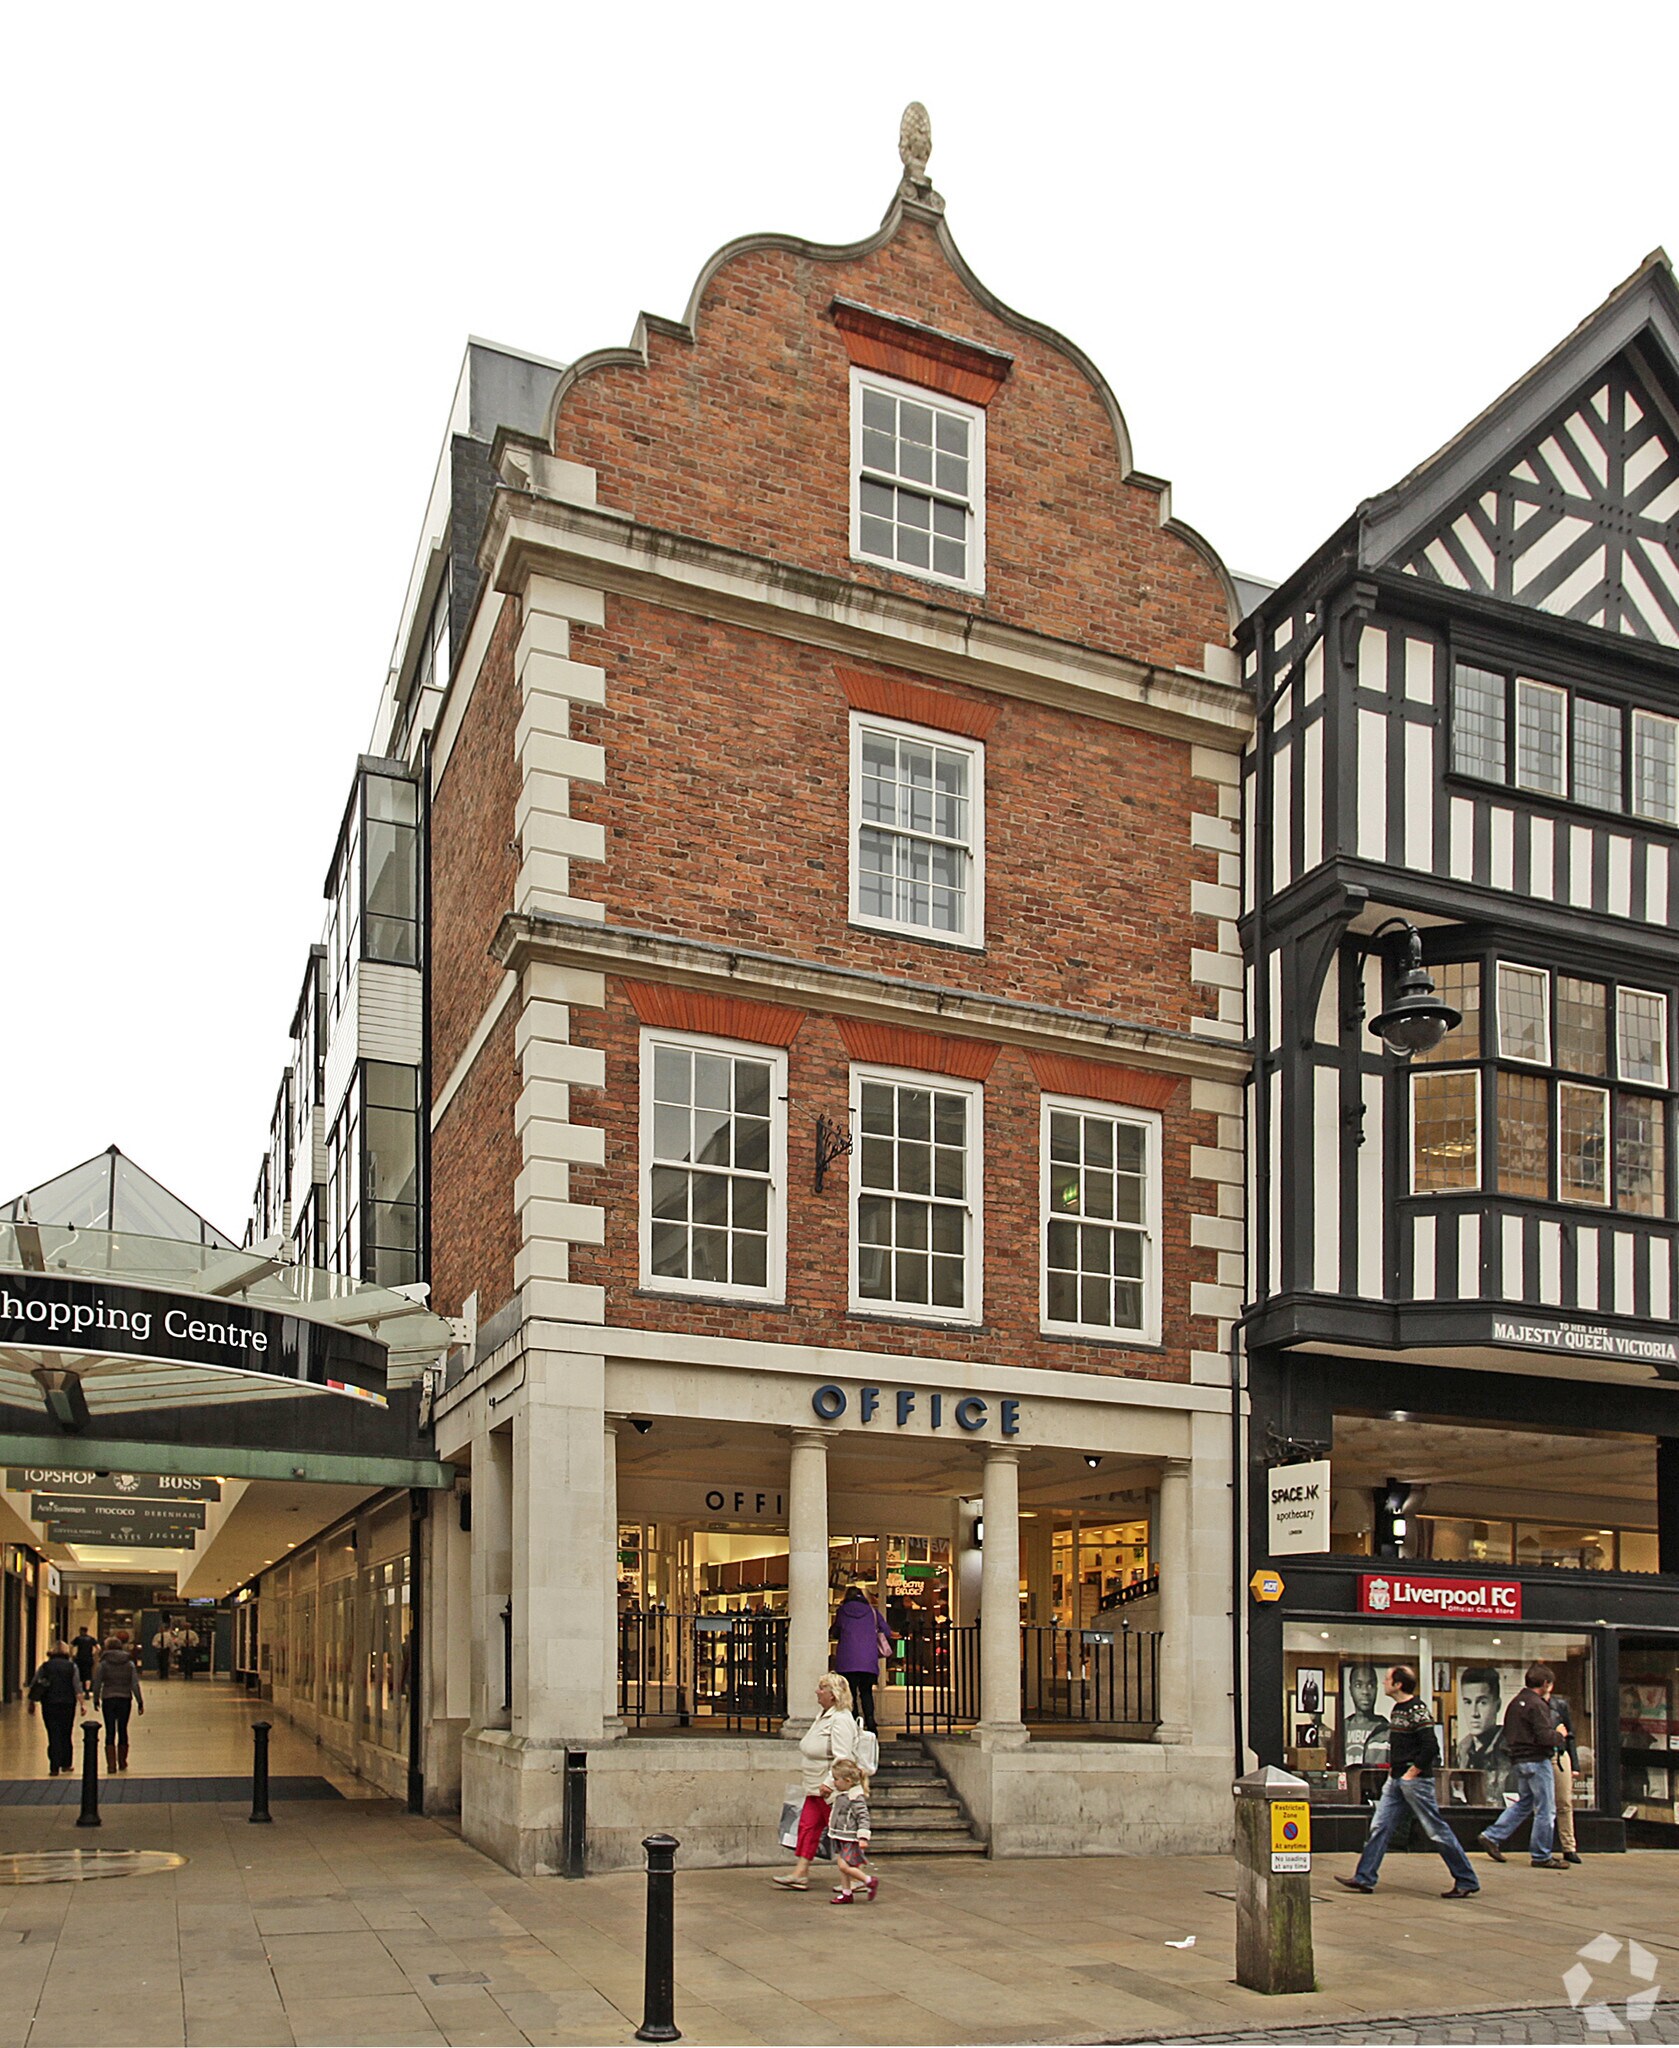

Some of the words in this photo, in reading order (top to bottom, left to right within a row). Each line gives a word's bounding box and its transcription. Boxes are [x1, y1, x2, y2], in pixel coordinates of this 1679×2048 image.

[0, 1290, 152, 1340] hopping
[164, 1309, 268, 1352] Centre
[1559, 1322, 1569, 1331] TO
[1571, 1324, 1586, 1333] HER
[1588, 1325, 1608, 1336] LATE
[1494, 1322, 1562, 1345] MAJESTY
[1565, 1331, 1613, 1352] QUEEN
[1616, 1337, 1677, 1359] VICTORIA
[812, 1384, 1020, 1435] OFFICE
[159, 1476, 202, 1490] BOSS
[705, 1490, 782, 1515] OFFI
[95, 1506, 135, 1516] mococo
[144, 1509, 201, 1519] DEBENHAMS
[1276, 1508, 1315, 1523] apothecary
[1393, 1582, 1487, 1610] Liverpool
[1491, 1586, 1517, 1608] FC
[1448, 1605, 1474, 1613] Official
[1476, 1606, 1493, 1614] Club
[1495, 1607, 1515, 1615] Store
[1285, 1855, 1307, 1863] loading
